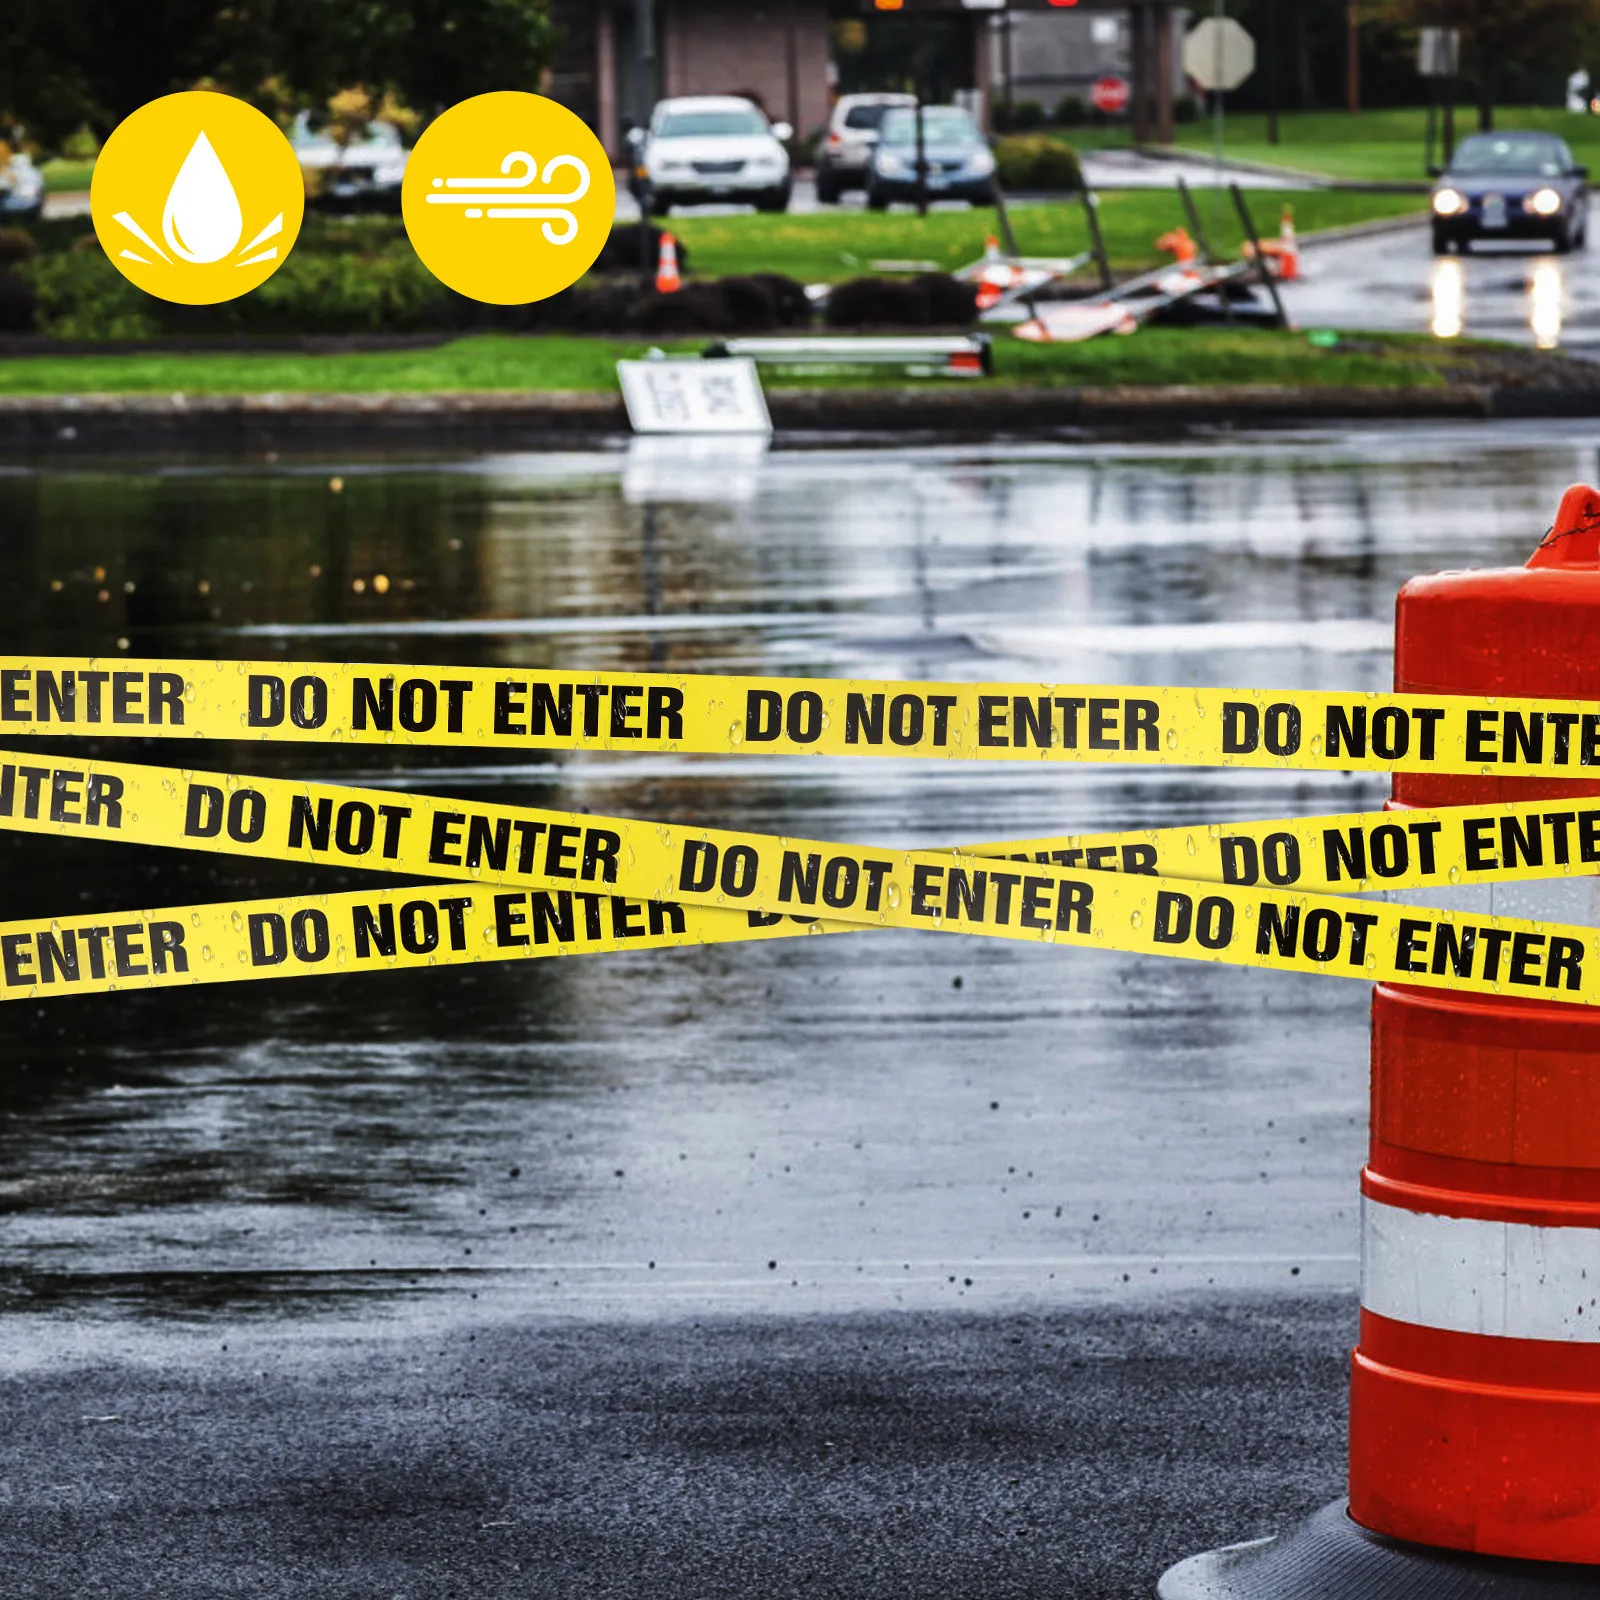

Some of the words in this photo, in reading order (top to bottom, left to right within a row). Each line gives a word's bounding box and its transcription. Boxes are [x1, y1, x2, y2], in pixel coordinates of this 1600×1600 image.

[0, 669, 185, 725] ENTER
[248, 674, 328, 730] DO
[352, 677, 473, 734] NOT
[493, 681, 684, 740] ENTER
[745, 689, 823, 744] DO
[845, 692, 957, 746] NOT
[978, 696, 1160, 752] ENTER
[1222, 702, 1302, 757] DO
[1325, 705, 1445, 761] NOT
[1, 921, 189, 987] ENTER
[247, 908, 330, 967] DO
[351, 896, 472, 959] NOT
[1219, 832, 1301, 887] DO
[1322, 821, 1442, 882] NOT
[184, 783, 267, 843] DO
[287, 795, 412, 860] NOT
[428, 810, 621, 884] ENTER
[678, 839, 759, 898] DO
[777, 850, 893, 912] NOT
[910, 864, 1094, 934] ENTER
[1153, 890, 1235, 950] DO
[1255, 902, 1379, 966] NOT
[1394, 918, 1585, 991] ENTER
